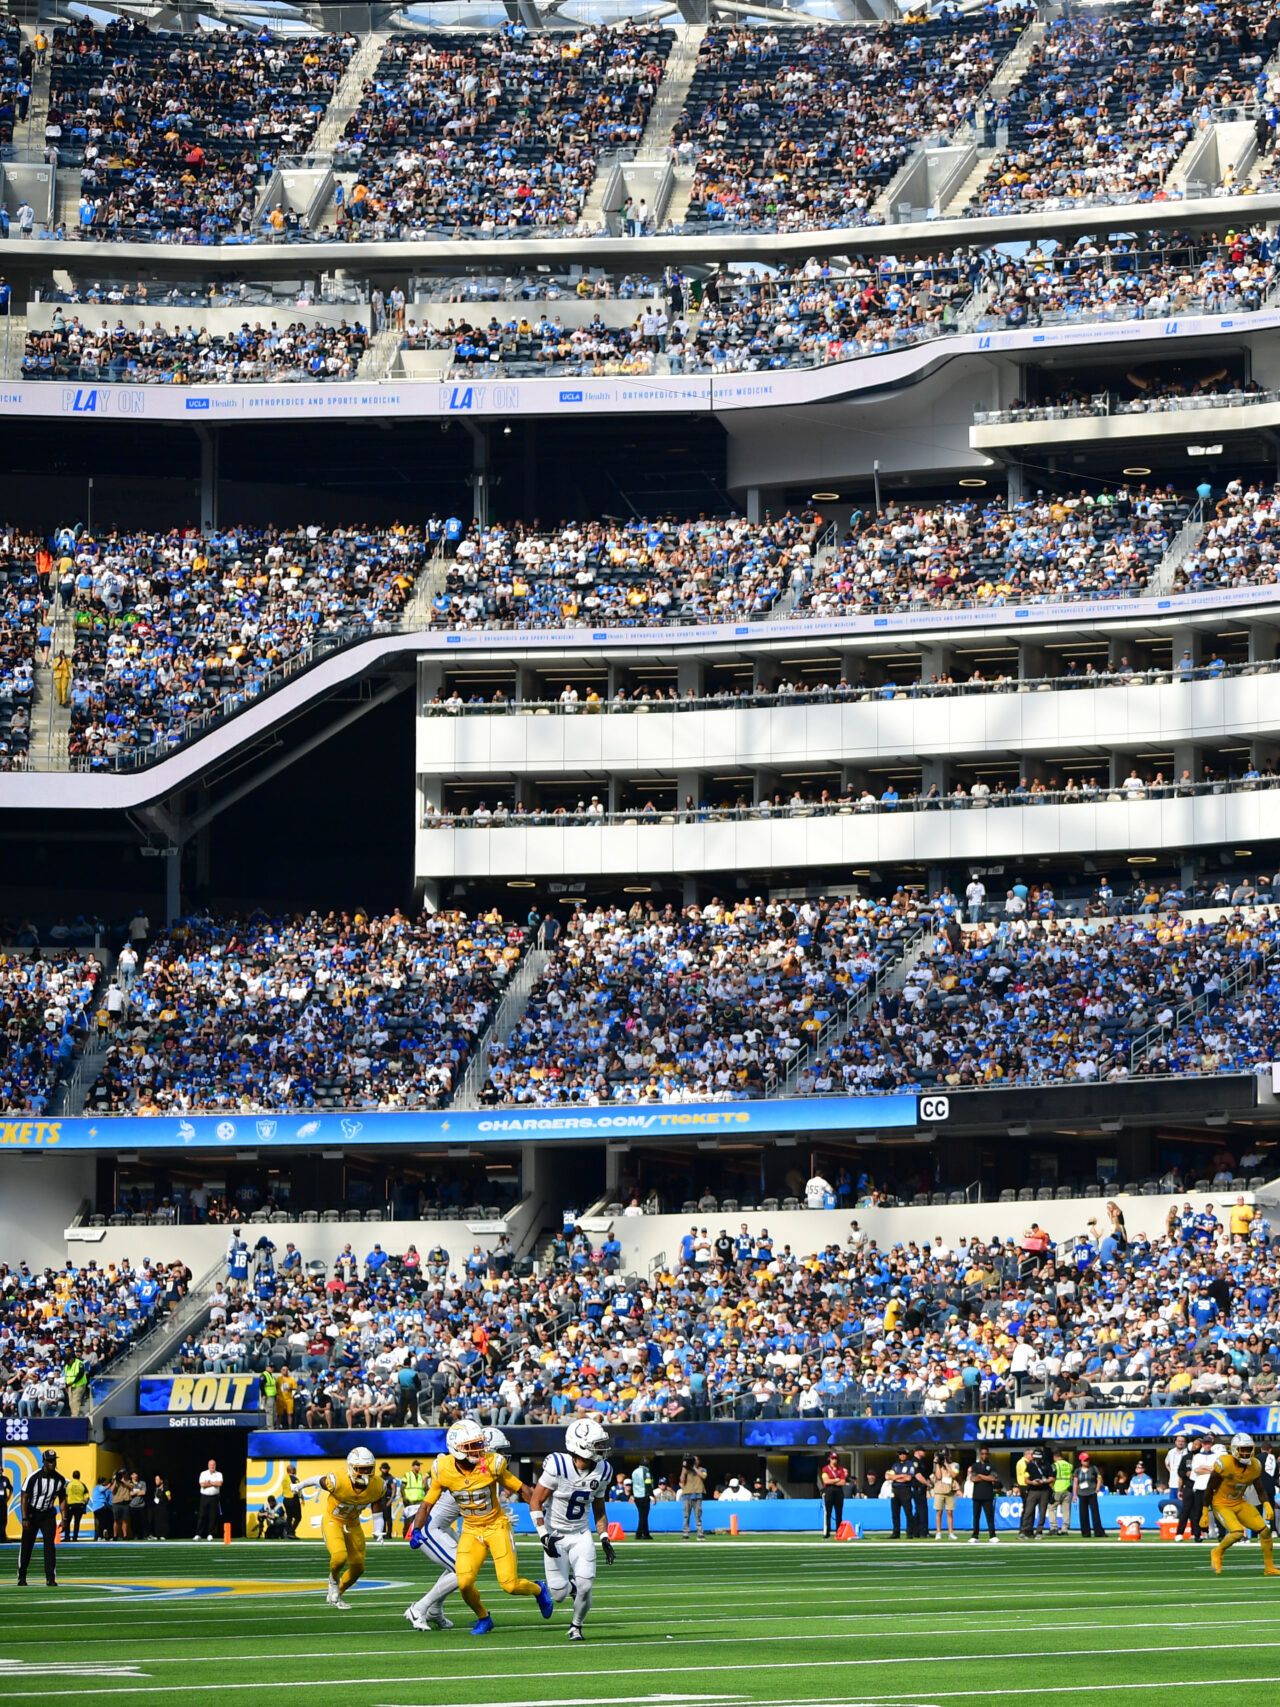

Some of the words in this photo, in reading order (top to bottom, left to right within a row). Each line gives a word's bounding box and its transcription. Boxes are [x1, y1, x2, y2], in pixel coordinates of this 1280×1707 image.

[250, 398, 304, 406] ORTHOPEDICS
[328, 397, 357, 405] SPORTS
[362, 396, 399, 404] MEDICINE
[583, 392, 610, 400] Health
[623, 391, 679, 399] ORTHOPEDICS
[702, 388, 732, 397] SPORTS
[736, 386, 772, 395] MEDICINE
[924, 1100, 946, 1118] CC
[477, 1111, 750, 1132] CHARGERS.COM/TICKETS
[235, 1254, 247, 1268] 18
[46, 1389, 56, 1399] 10
[168, 1377, 254, 1411] BOLT
[169, 1418, 188, 1427] SoFi
[199, 1417, 236, 1427] Stadium
[976, 1416, 1007, 1440] SEE
[1009, 1413, 1042, 1438] THE
[1042, 1410, 1136, 1438] LIGHTNING
[566, 1490, 590, 1520] 6
